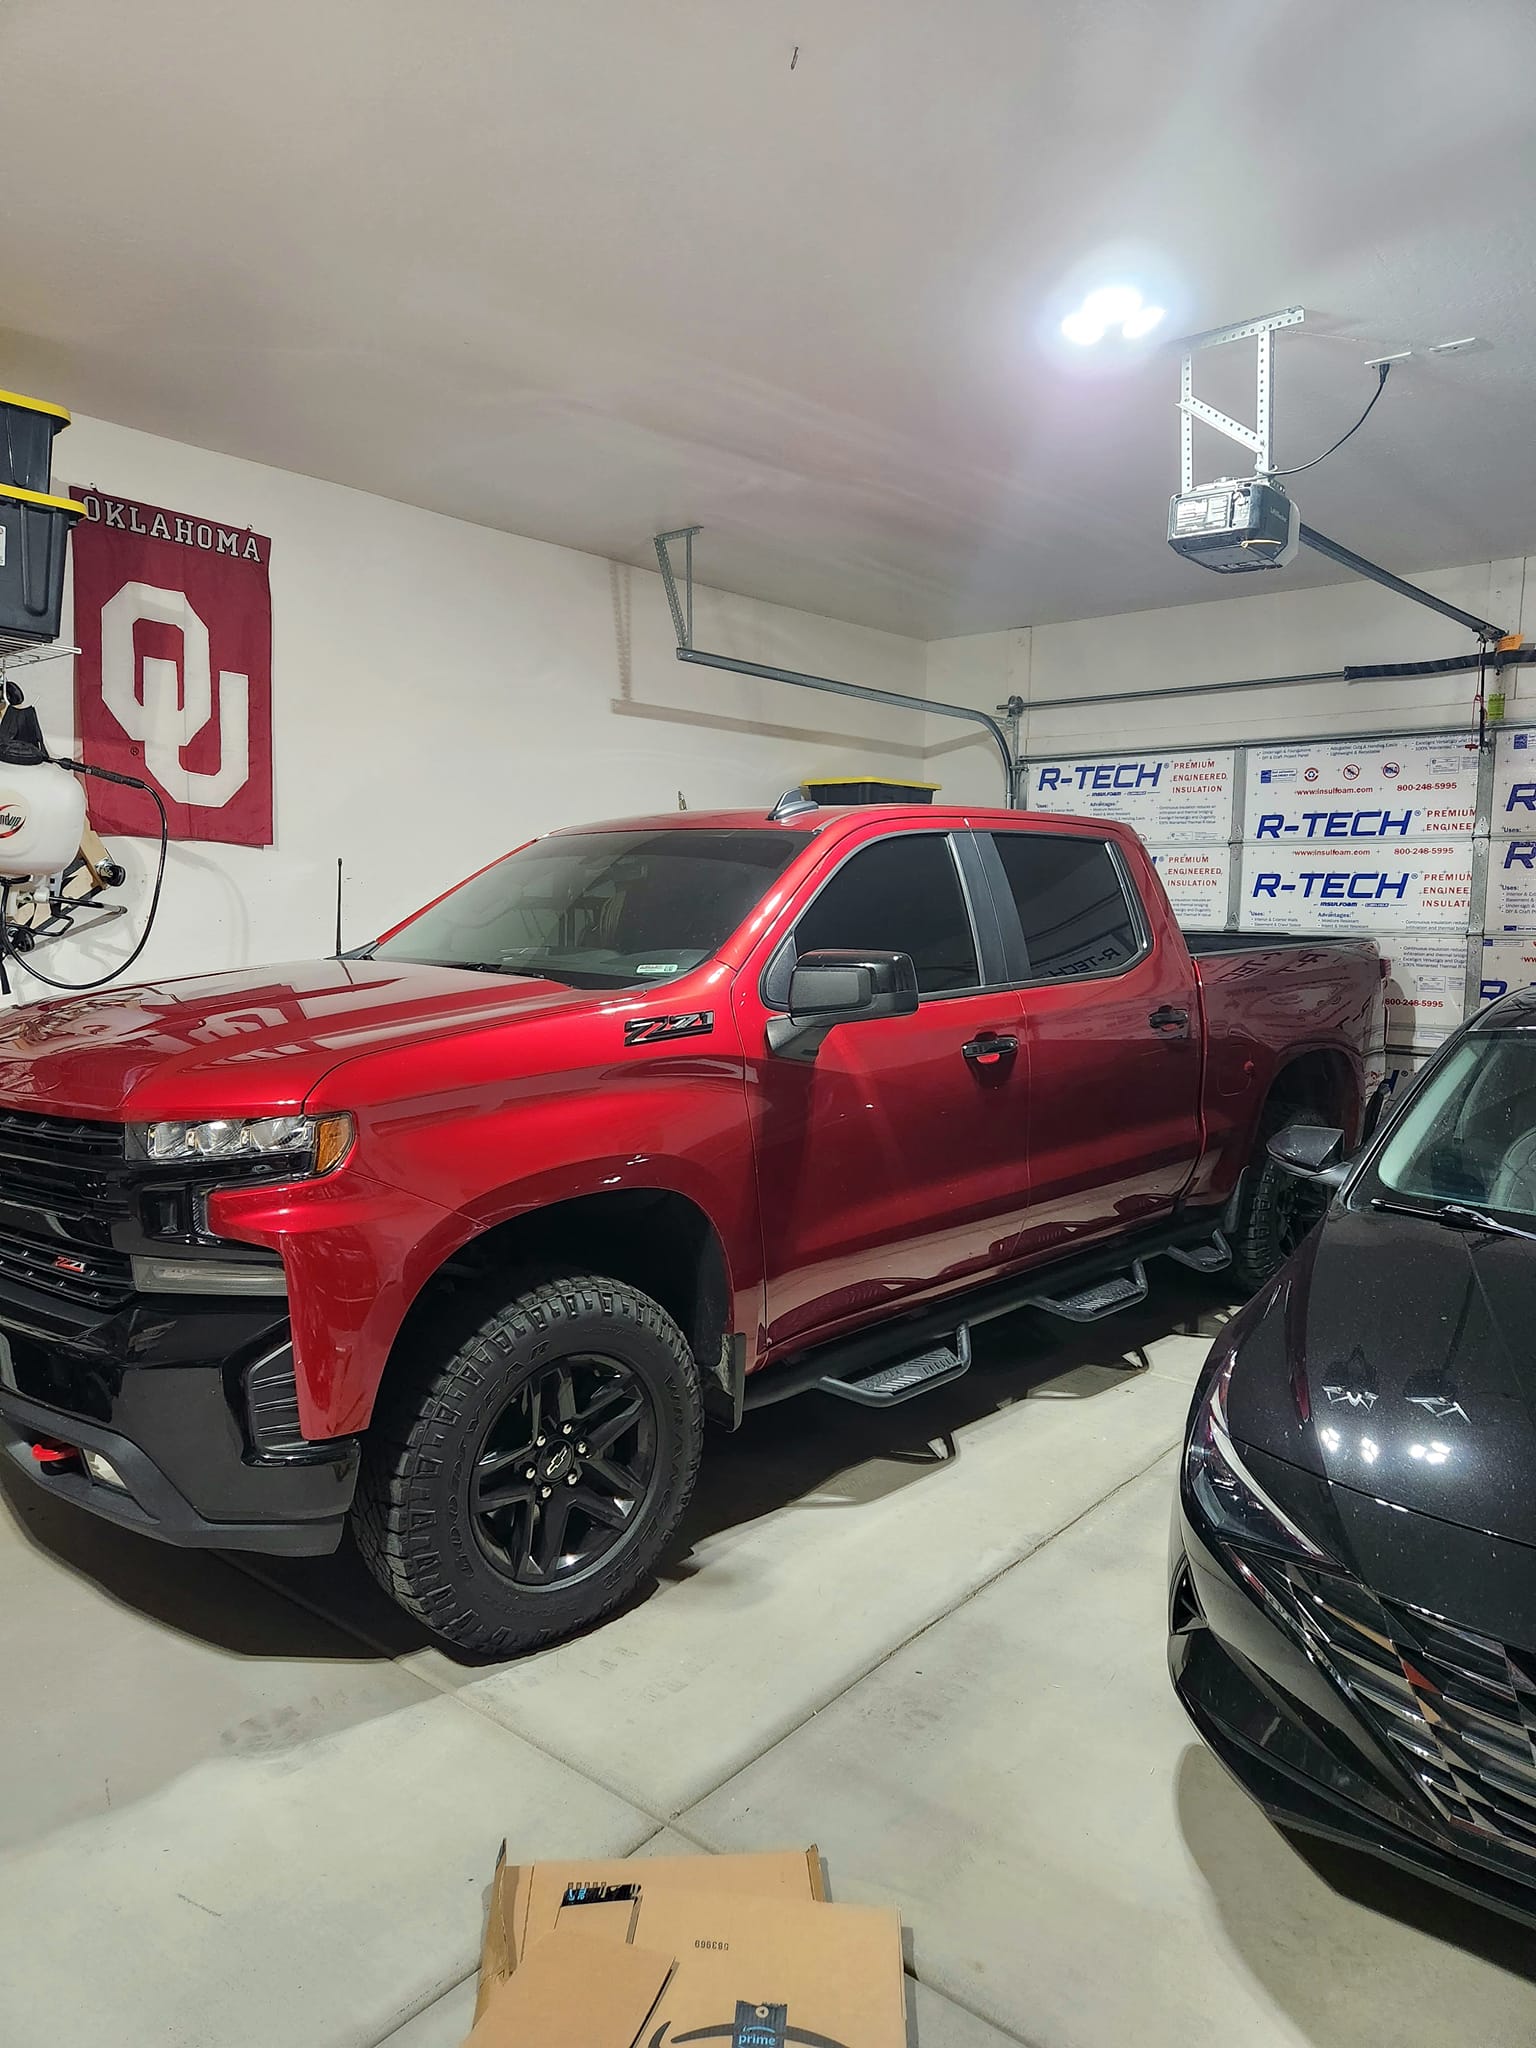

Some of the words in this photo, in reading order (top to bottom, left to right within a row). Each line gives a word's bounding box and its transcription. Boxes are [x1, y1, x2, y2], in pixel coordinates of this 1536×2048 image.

[83, 495, 262, 563] OKLAHOMA
[101, 581, 249, 808] OU
[1174, 761, 1215, 769] PREMIUM
[1039, 763, 1163, 791] R-TECH
[1172, 773, 1227, 782] ENGINEERED
[1172, 785, 1223, 793] INSULATION
[1296, 786, 1373, 795] www.insulfoam.com
[1397, 782, 1457, 792] 800-248-5995
[1256, 809, 1412, 839] R-TECH
[1295, 849, 1370, 857] www.insulfoam.com
[1394, 847, 1454, 855] 800-248-5995
[1252, 873, 1410, 899] R-TECH
[1384, 997, 1444, 1008] 800-248-5995
[738, 2034, 776, 2046] prime
